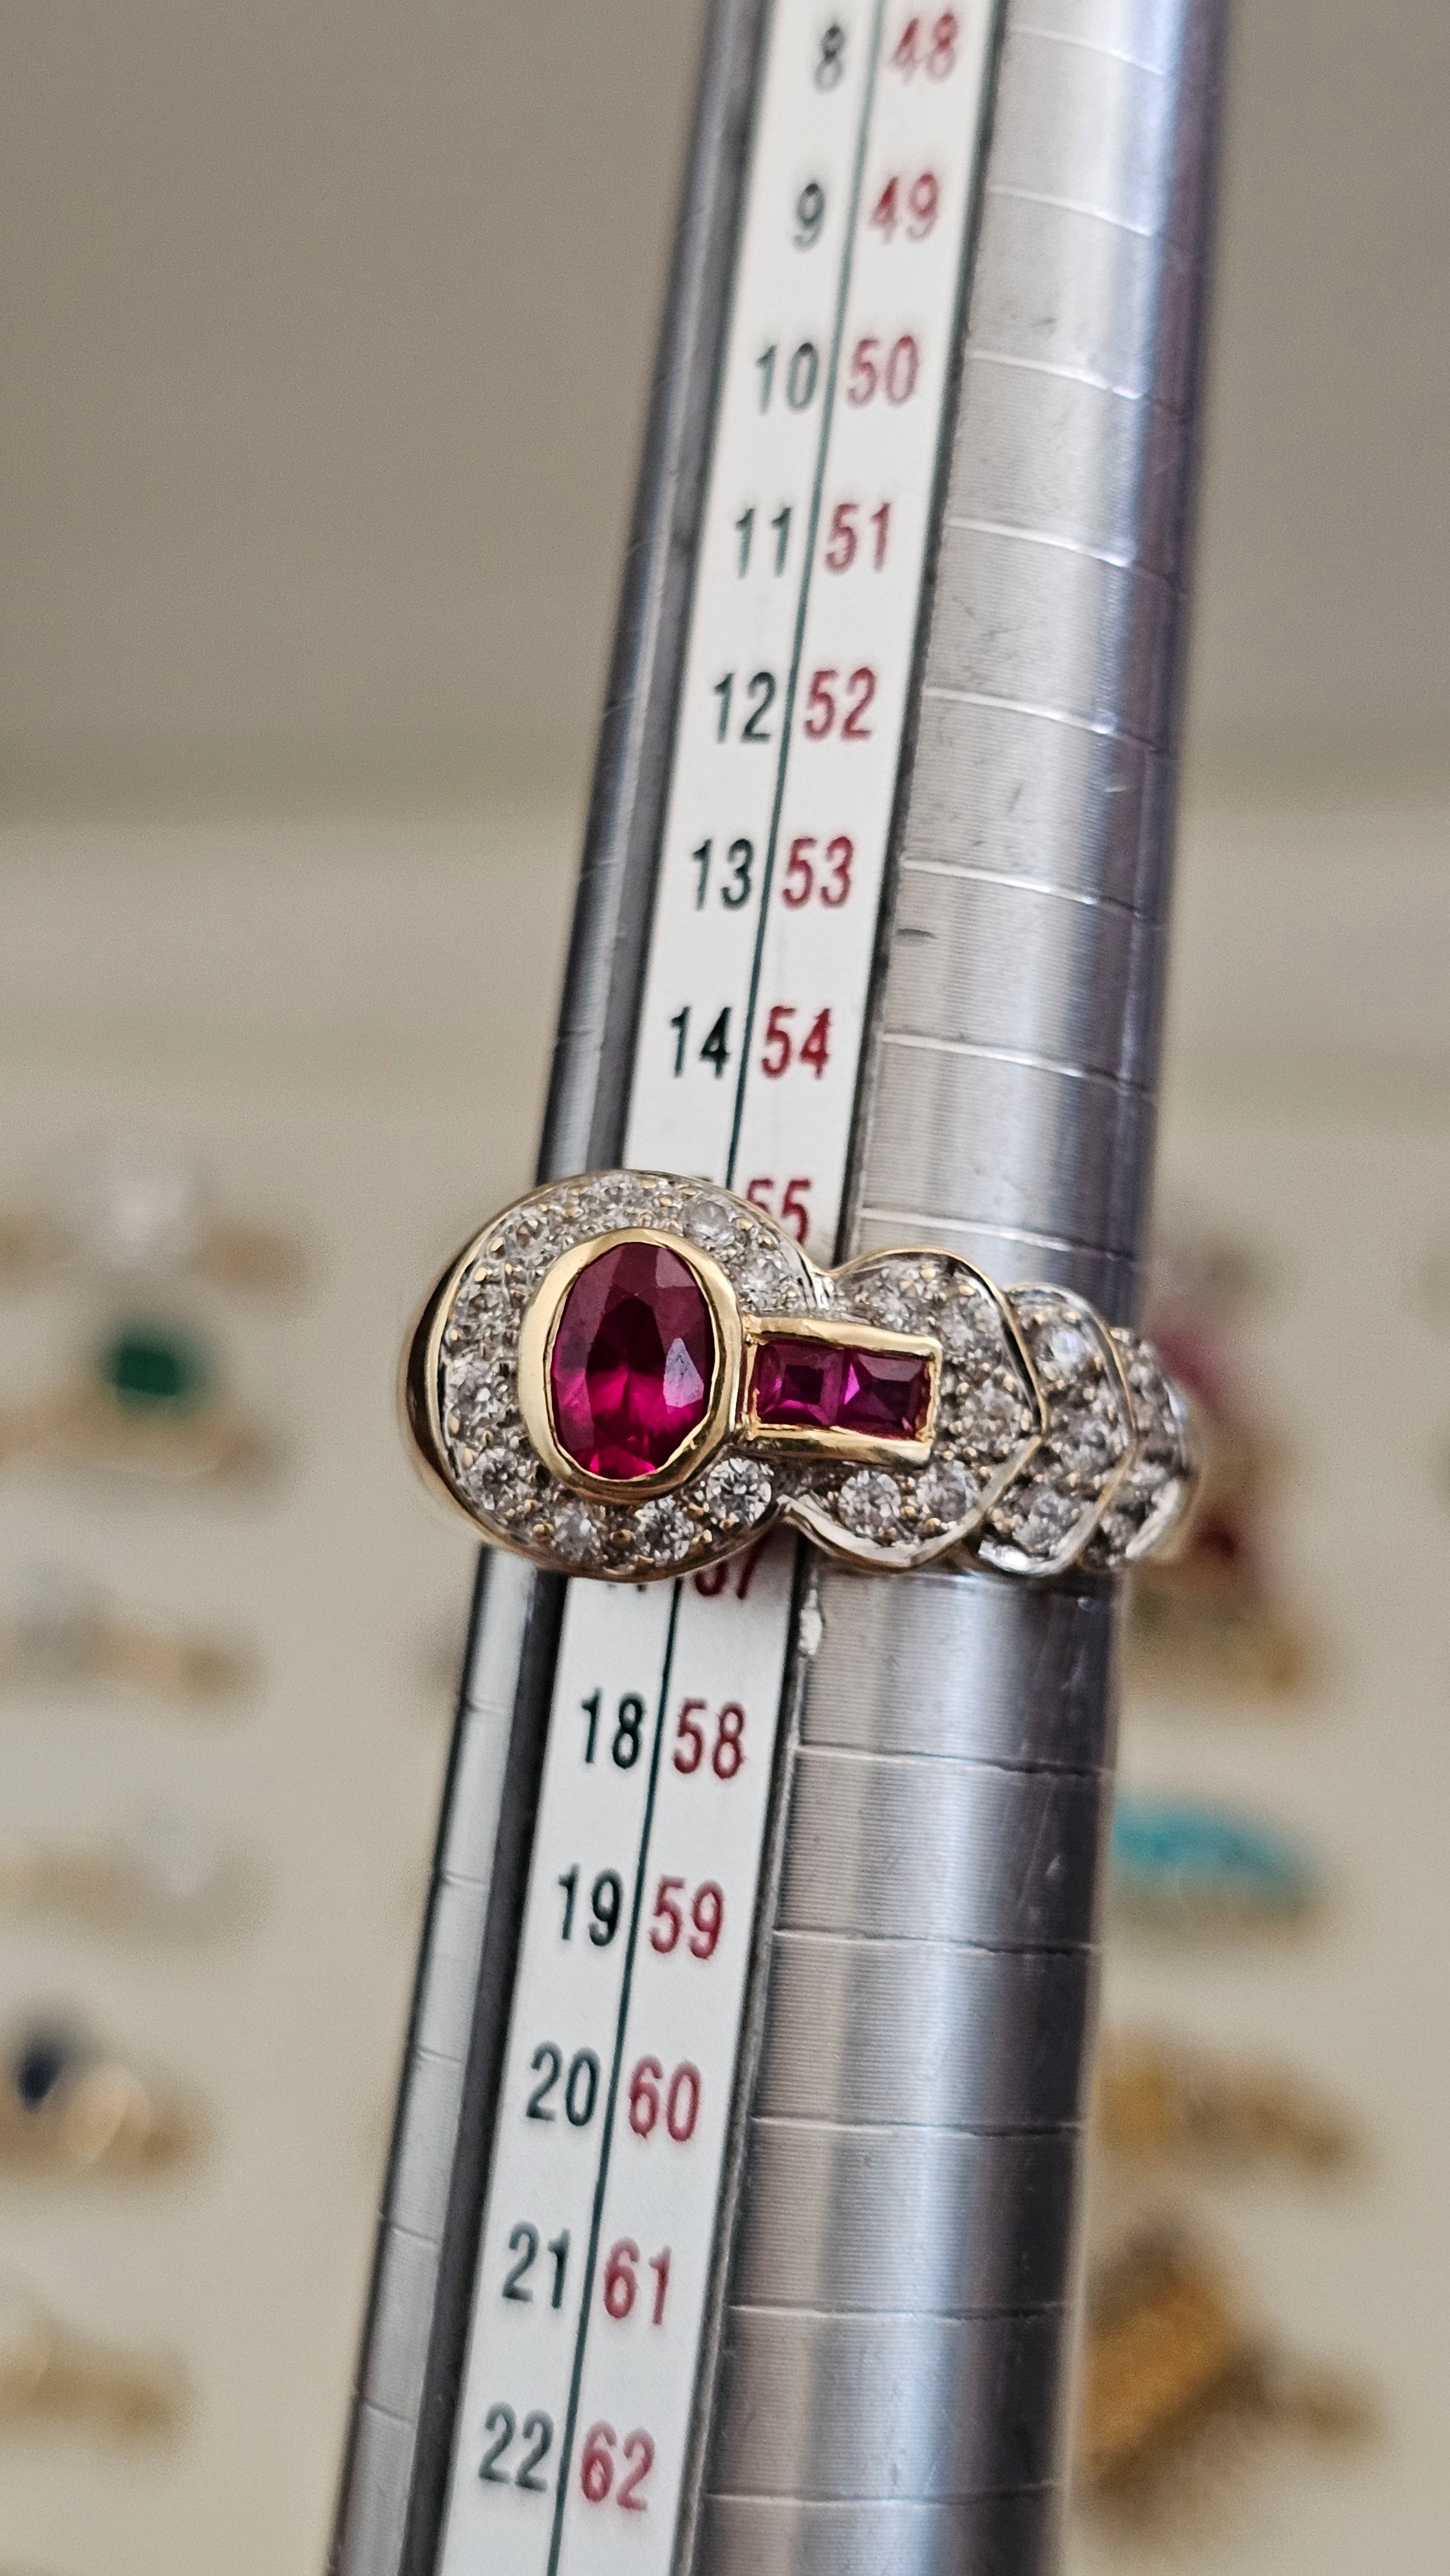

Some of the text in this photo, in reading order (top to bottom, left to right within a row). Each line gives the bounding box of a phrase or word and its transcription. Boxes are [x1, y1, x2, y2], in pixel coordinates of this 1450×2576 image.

[814, 10, 958, 93] 8 48
[793, 170, 940, 251] 9 49
[756, 334, 920, 412] 10 50
[735, 502, 892, 575] 11 51
[713, 666, 877, 744] 12 52
[692, 835, 854, 911] 13 53
[670, 1005, 831, 1080] 14 54
[581, 1688, 747, 1781] 18 58
[558, 1864, 725, 1961] 19 59
[525, 2043, 702, 2144] 20 60
[502, 2221, 672, 2325] 21 61
[478, 2403, 655, 2513] 22 62
